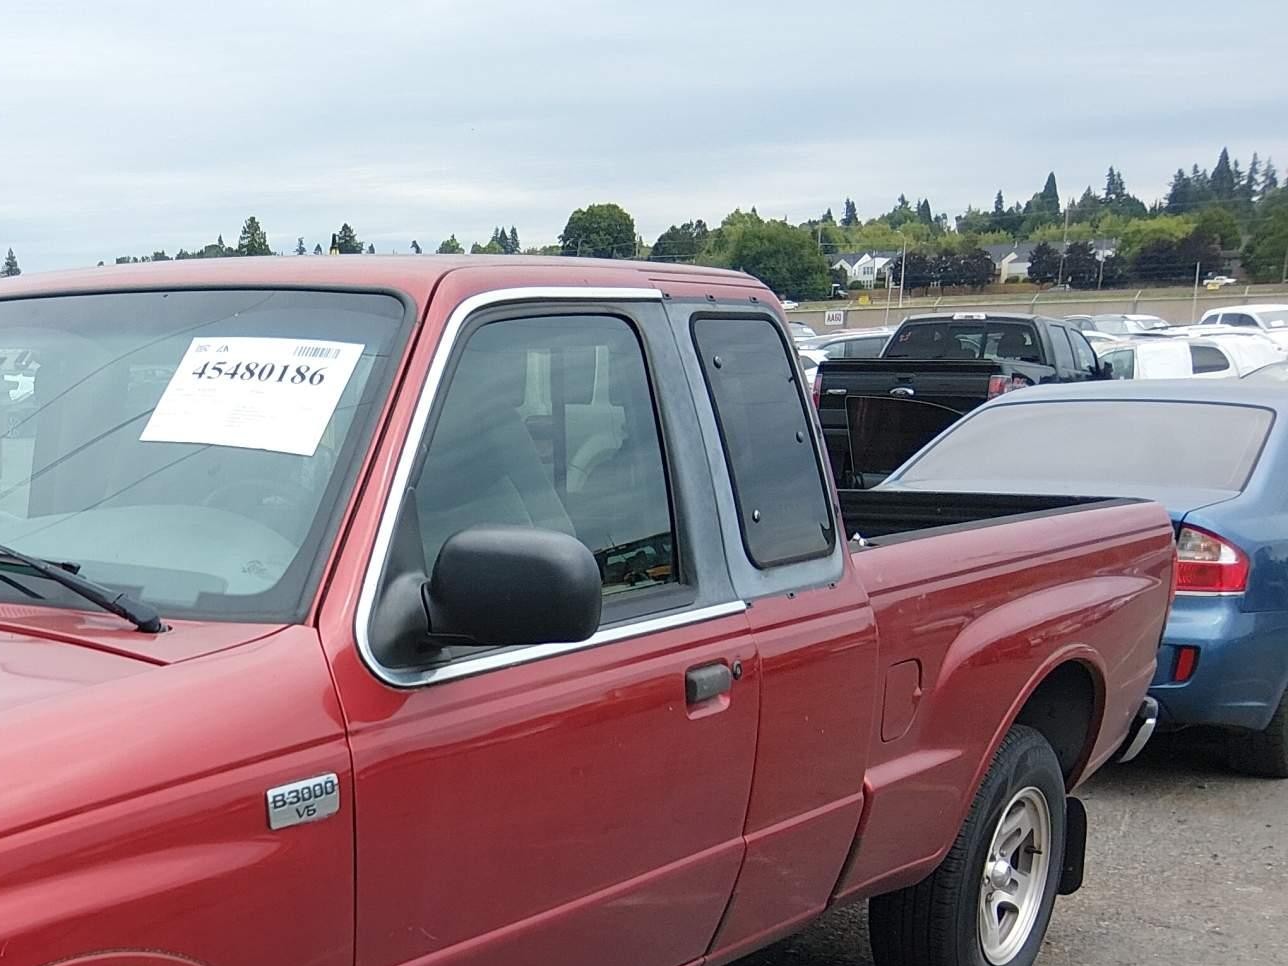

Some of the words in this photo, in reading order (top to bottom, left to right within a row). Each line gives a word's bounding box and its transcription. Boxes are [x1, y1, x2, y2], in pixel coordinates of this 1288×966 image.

[192, 361, 328, 386] 45480186
[272, 780, 335, 809] B3000
[296, 804, 317, 818] V6
